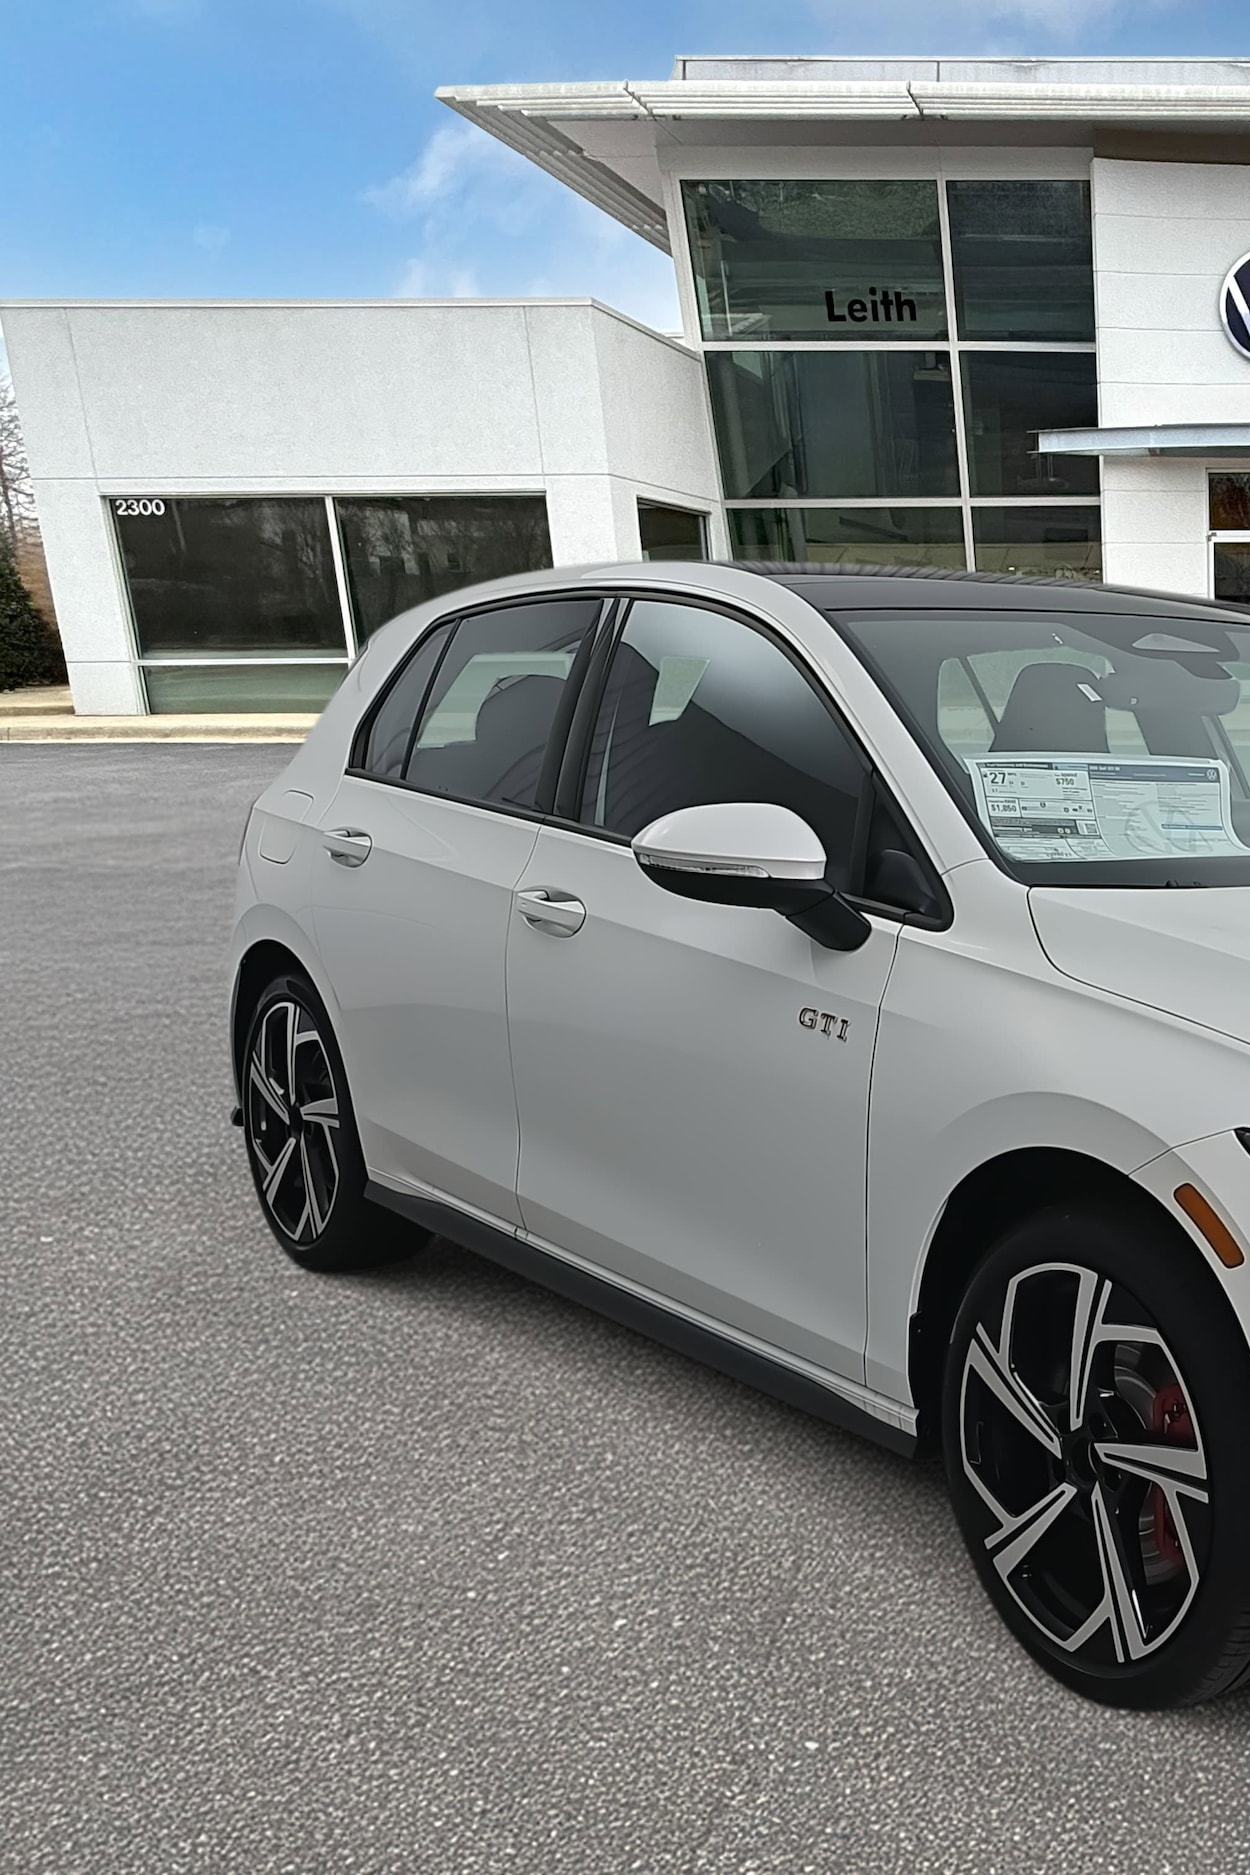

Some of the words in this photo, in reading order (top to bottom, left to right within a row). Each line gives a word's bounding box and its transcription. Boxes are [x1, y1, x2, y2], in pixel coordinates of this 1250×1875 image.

[825, 286, 917, 322] Leith
[115, 499, 165, 516] 2300
[989, 772, 1006, 784] 27
[1055, 777, 1075, 786] $750
[799, 1007, 850, 1043] GTI
